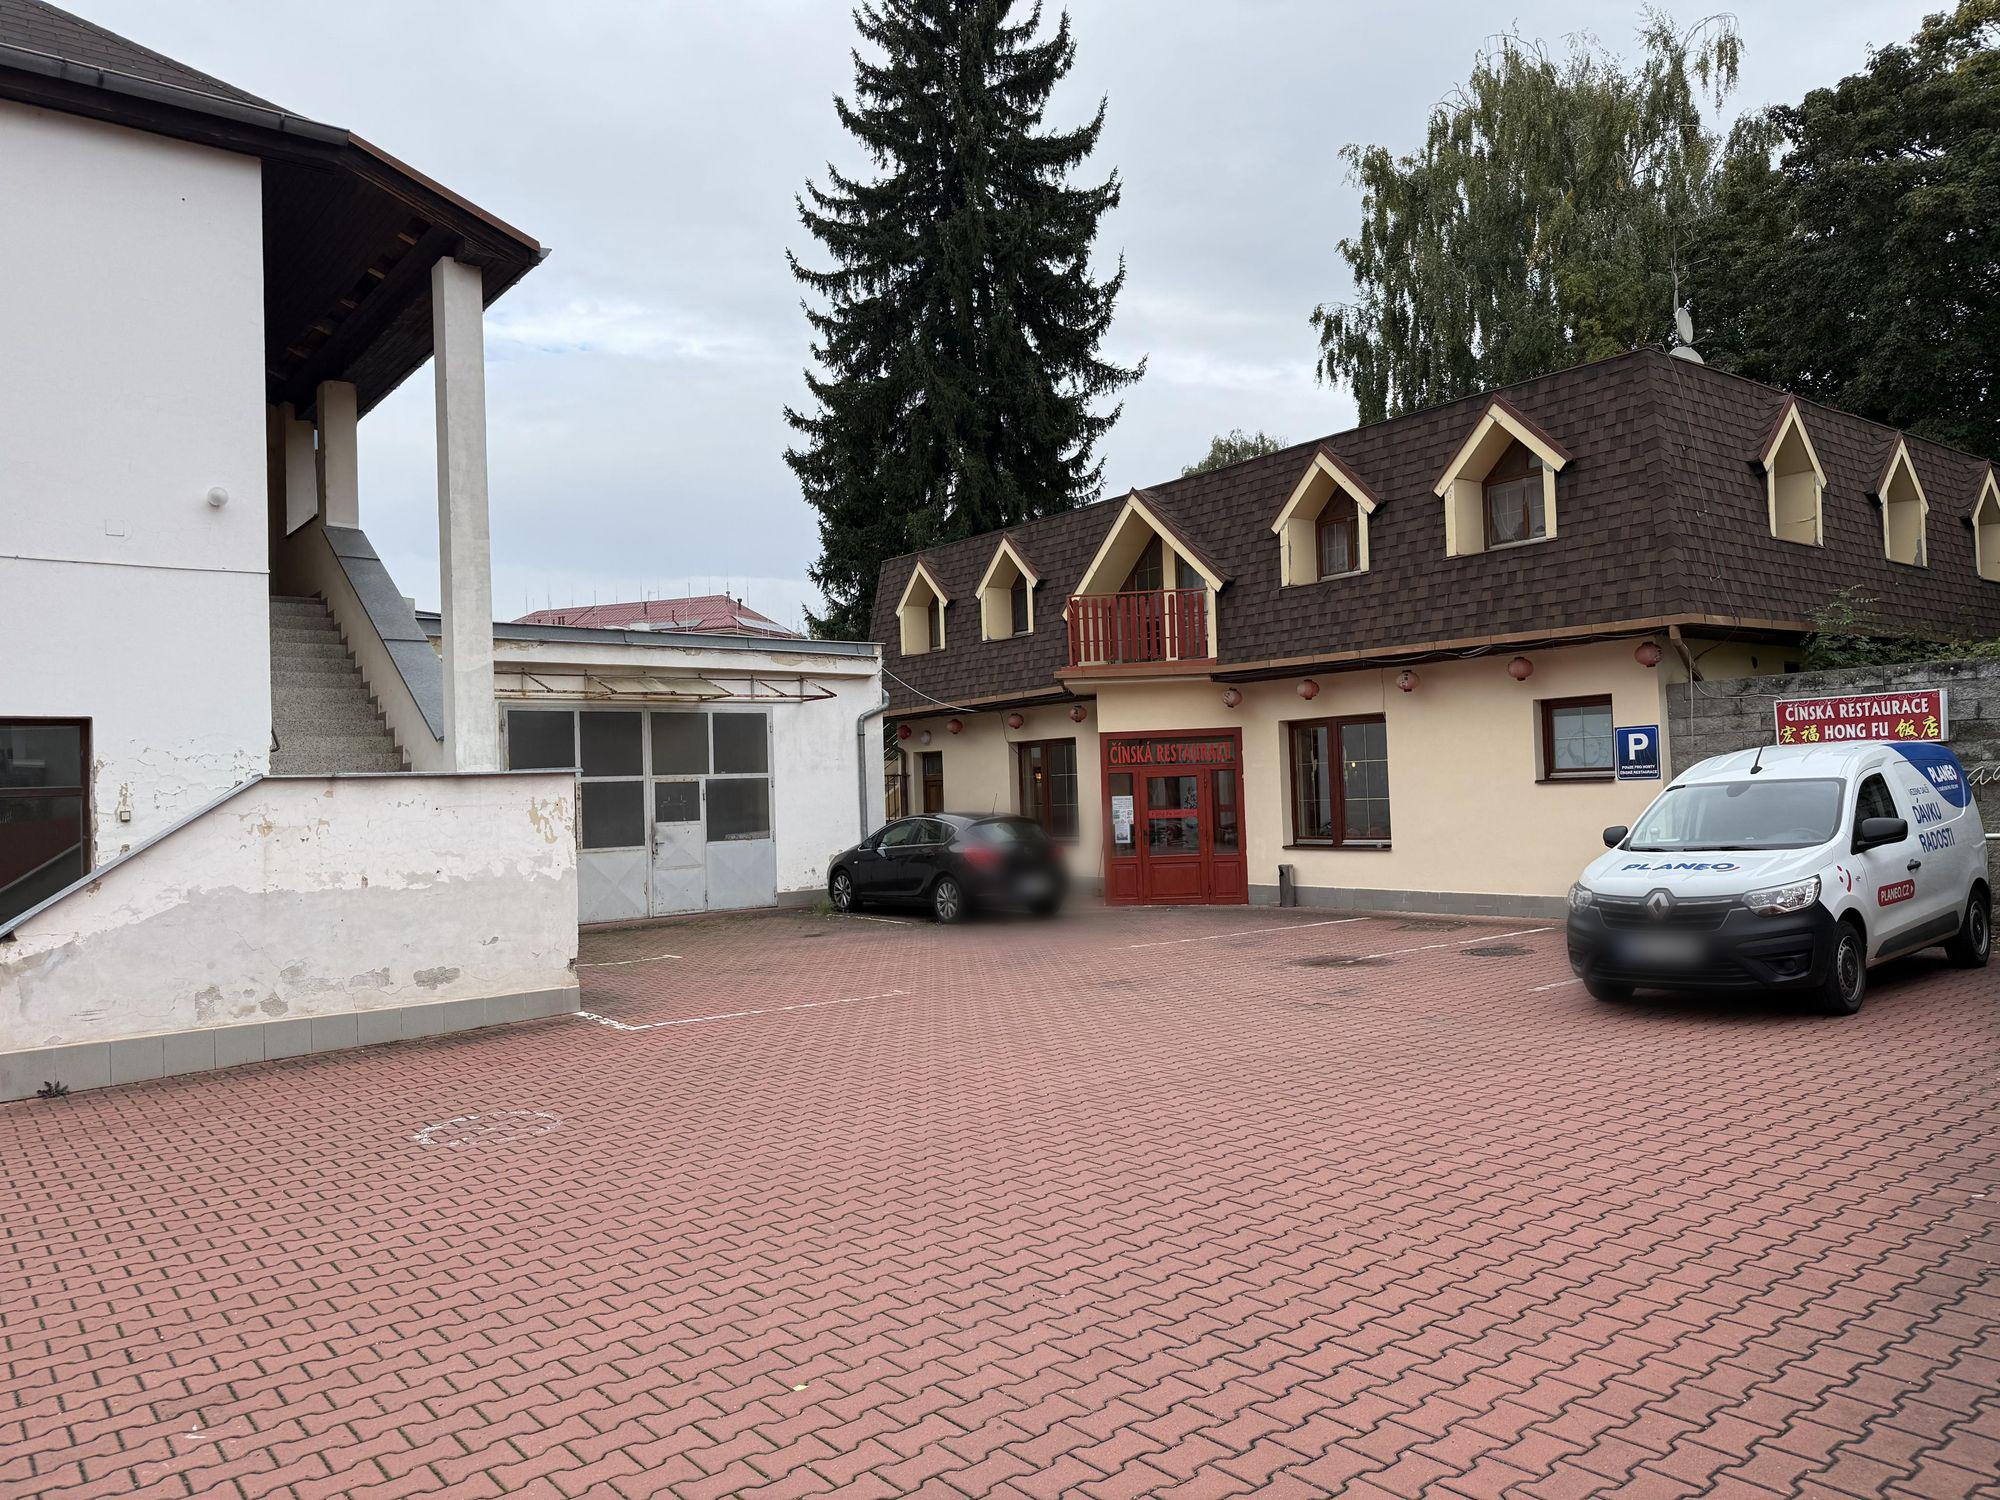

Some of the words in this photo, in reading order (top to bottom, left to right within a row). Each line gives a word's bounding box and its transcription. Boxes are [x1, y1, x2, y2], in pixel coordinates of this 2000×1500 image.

[1785, 702, 1835, 721] ČÍNSKÁ
[1839, 698, 1929, 718] RESTAURACE
[1824, 723, 1866, 740] HONG
[1871, 722, 1889, 737] FU
[1110, 741, 1153, 764] ČÍNSKÁ
[1628, 733, 1649, 760] P
[1927, 765, 1958, 783] PLANEO
[1912, 798, 1942, 824] DÁVKU
[1919, 828, 1955, 853] RADOSTI
[1621, 862, 1736, 872] PLANEO
[1880, 884, 1910, 903] PLANEO.CZ
